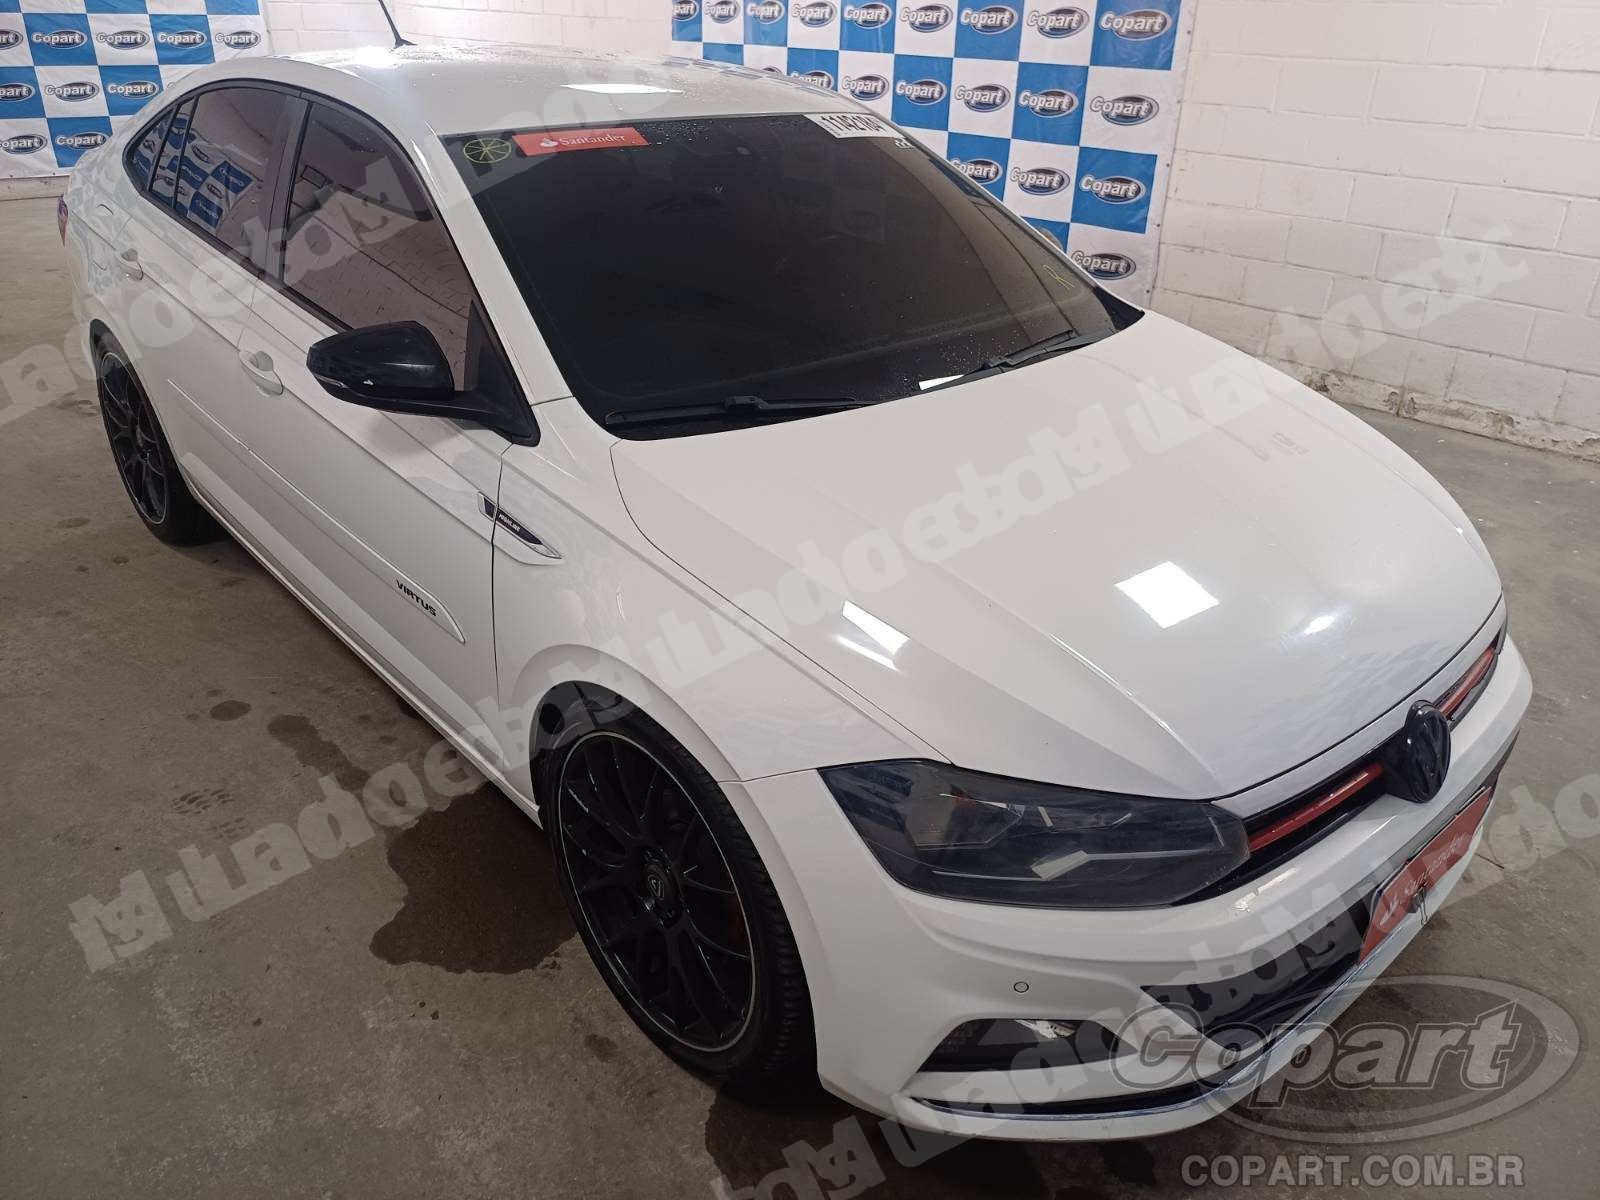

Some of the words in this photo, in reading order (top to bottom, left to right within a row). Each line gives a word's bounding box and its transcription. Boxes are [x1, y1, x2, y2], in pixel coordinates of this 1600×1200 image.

[704, 2, 736, 17] Copart
[747, 2, 779, 18] Copart
[792, 4, 831, 22] Copart
[844, 5, 886, 23] Copart
[900, 5, 946, 25] Copart
[960, 6, 1011, 27] Copart
[1026, 10, 1080, 31] Copart
[1101, 12, 1163, 32] Copart
[32, 32, 81, 45] Copart
[96, 32, 142, 45] Copart
[157, 32, 202, 45] Copart
[215, 32, 257, 45] Copart
[45, 84, 93, 97] Copart
[108, 83, 154, 96] Copart
[842, 76, 883, 95] Copart
[896, 80, 940, 101] Copart
[955, 85, 1004, 104] Copart
[1018, 90, 1070, 112] Copart
[1090, 96, 1150, 117] Copart
[56, 134, 104, 147] Copart
[559, 133, 626, 146] Santander
[1010, 167, 1061, 188] Copart
[1080, 176, 1137, 198] Copart
[1071, 251, 1127, 273] Copart
[396, 579, 437, 617] VIRTUS
